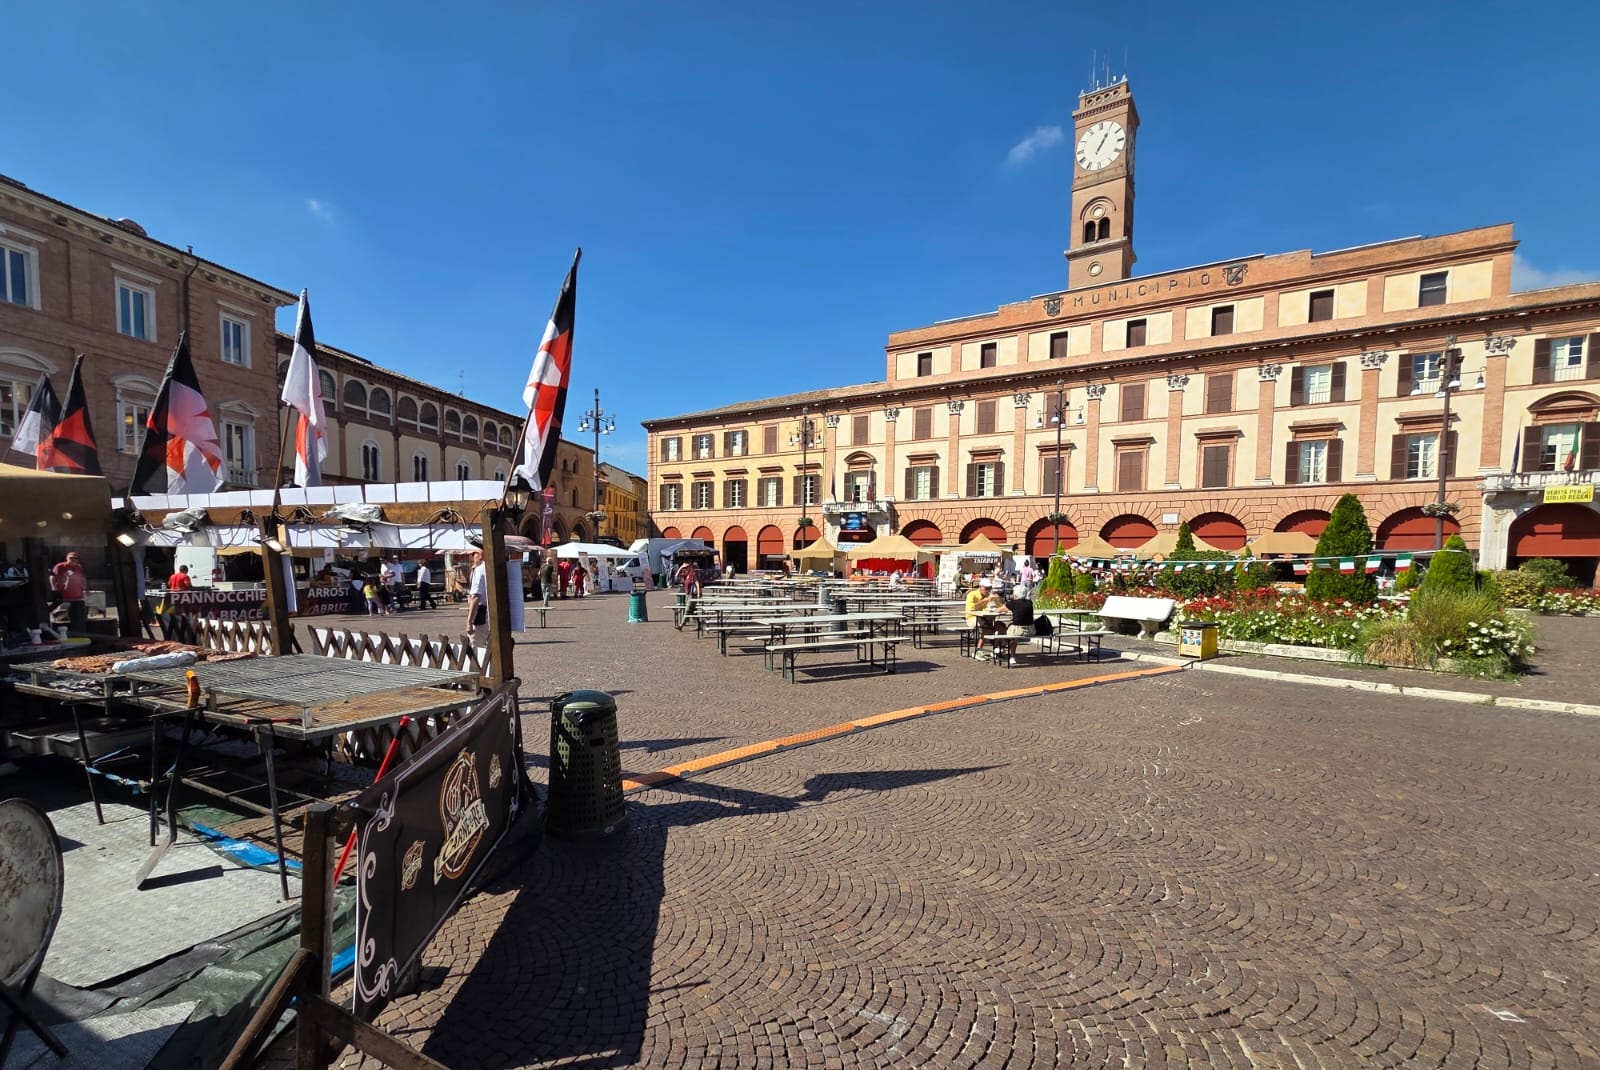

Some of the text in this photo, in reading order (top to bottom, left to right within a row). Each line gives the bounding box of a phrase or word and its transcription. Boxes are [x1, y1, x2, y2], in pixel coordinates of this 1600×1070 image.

[1073, 273, 1210, 307] MUNICIPIO
[171, 590, 267, 604] PANNOCCHIE
[220, 608, 264, 620] BRACE
